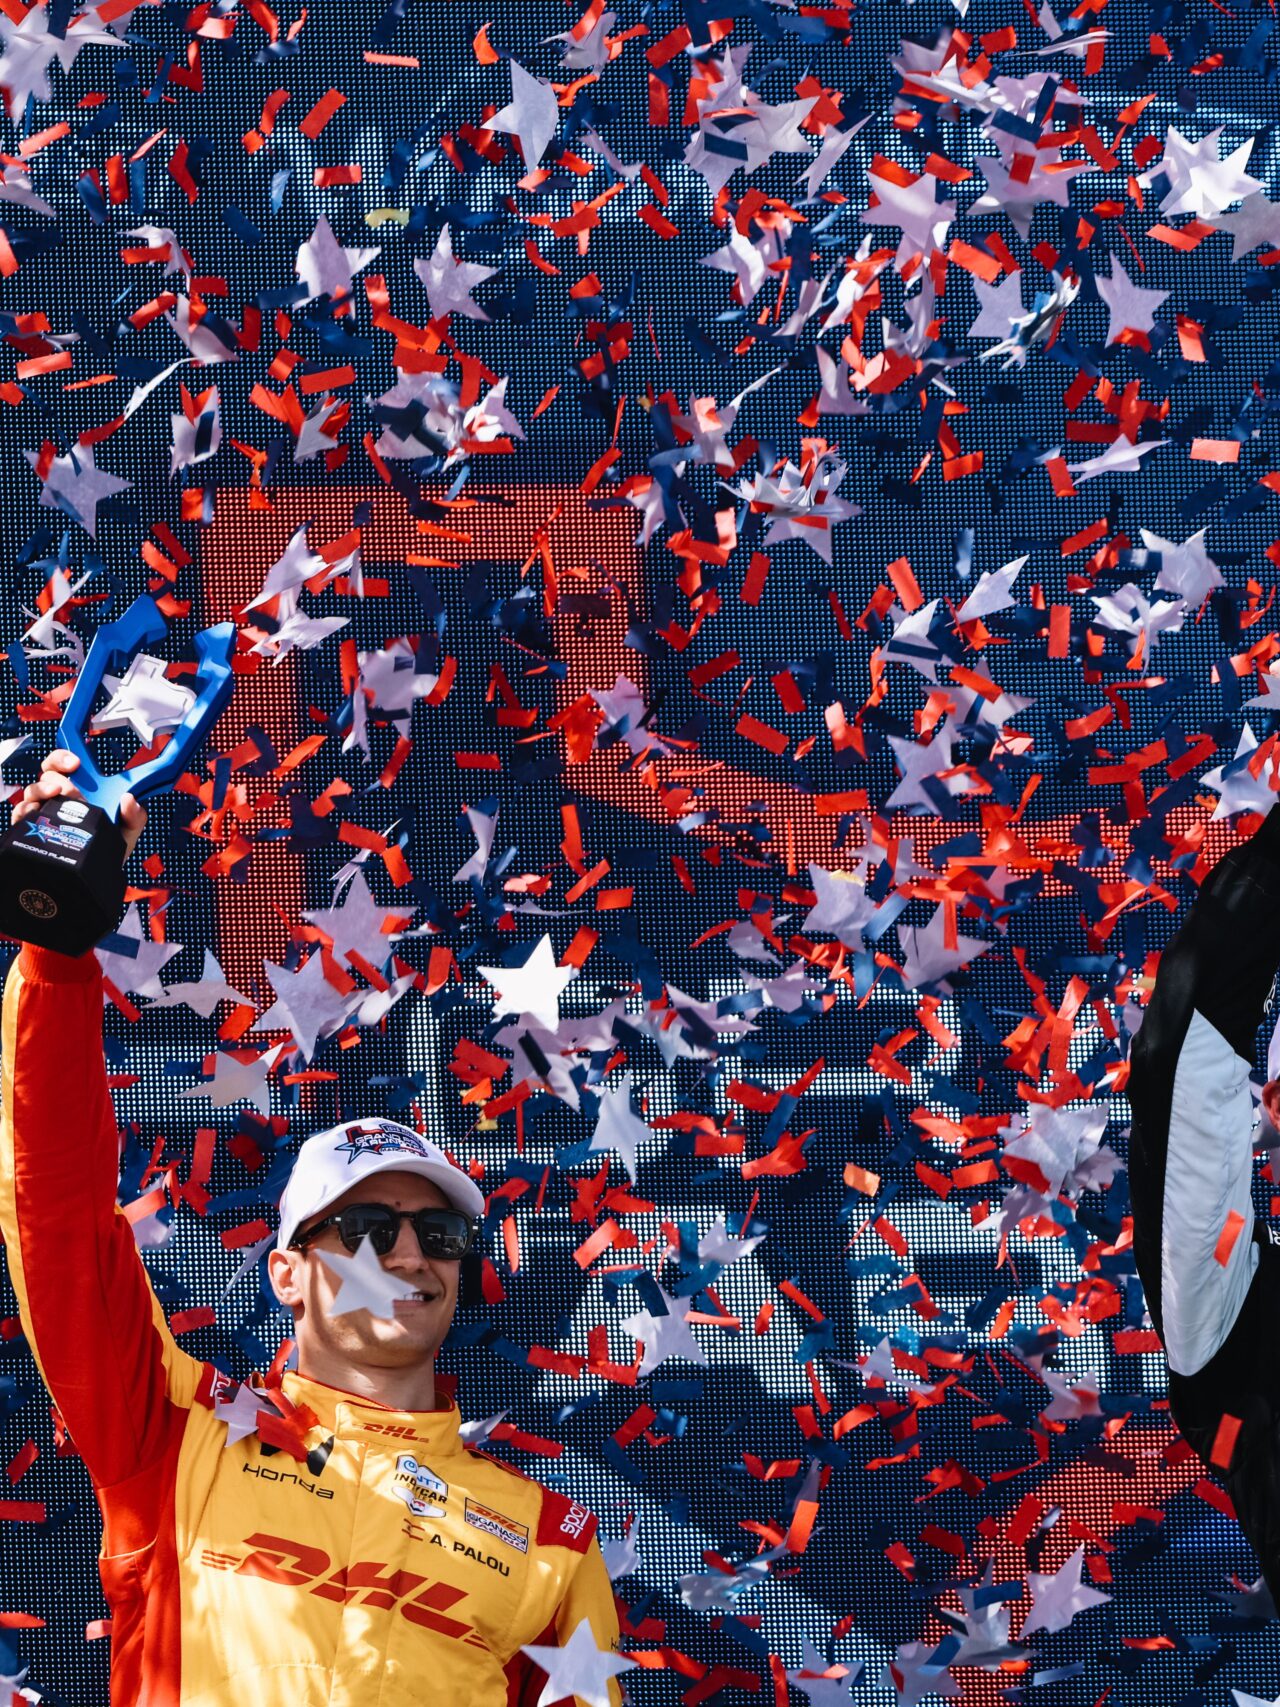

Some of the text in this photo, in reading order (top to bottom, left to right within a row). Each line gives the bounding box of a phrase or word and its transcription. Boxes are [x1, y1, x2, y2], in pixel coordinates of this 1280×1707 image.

[12, 840, 48, 856] SECOND
[47, 852, 77, 865] PLACE
[355, 1132, 401, 1145] GRAND
[362, 1422, 419, 1441] DHL
[475, 1505, 518, 1532] DHL
[478, 1516, 527, 1546] GANASSI
[430, 1534, 510, 1577] A. PALOU
[234, 1532, 475, 1640] DHL
